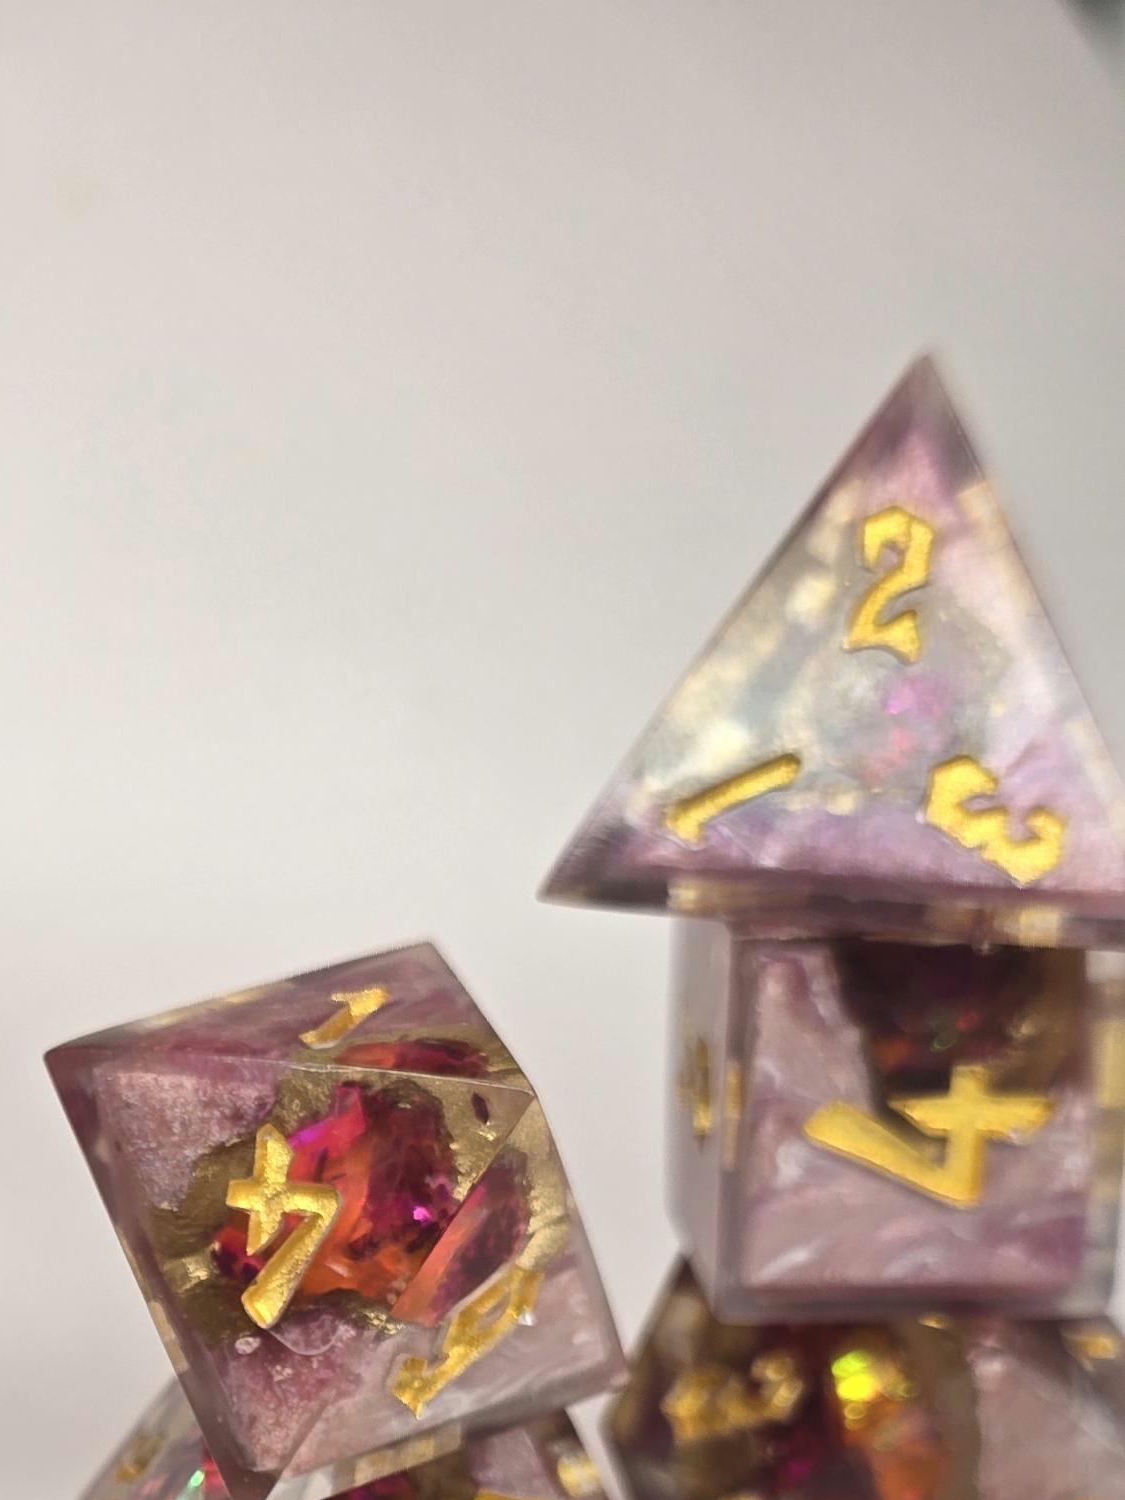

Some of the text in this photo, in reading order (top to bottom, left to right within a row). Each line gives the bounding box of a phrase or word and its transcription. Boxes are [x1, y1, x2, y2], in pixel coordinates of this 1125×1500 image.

[844, 505, 935, 664] 2
[663, 752, 802, 847] 1
[921, 755, 1067, 886] 3
[299, 986, 391, 1048] 1
[802, 1065, 1054, 1210] 4
[226, 1124, 343, 1328] 4
